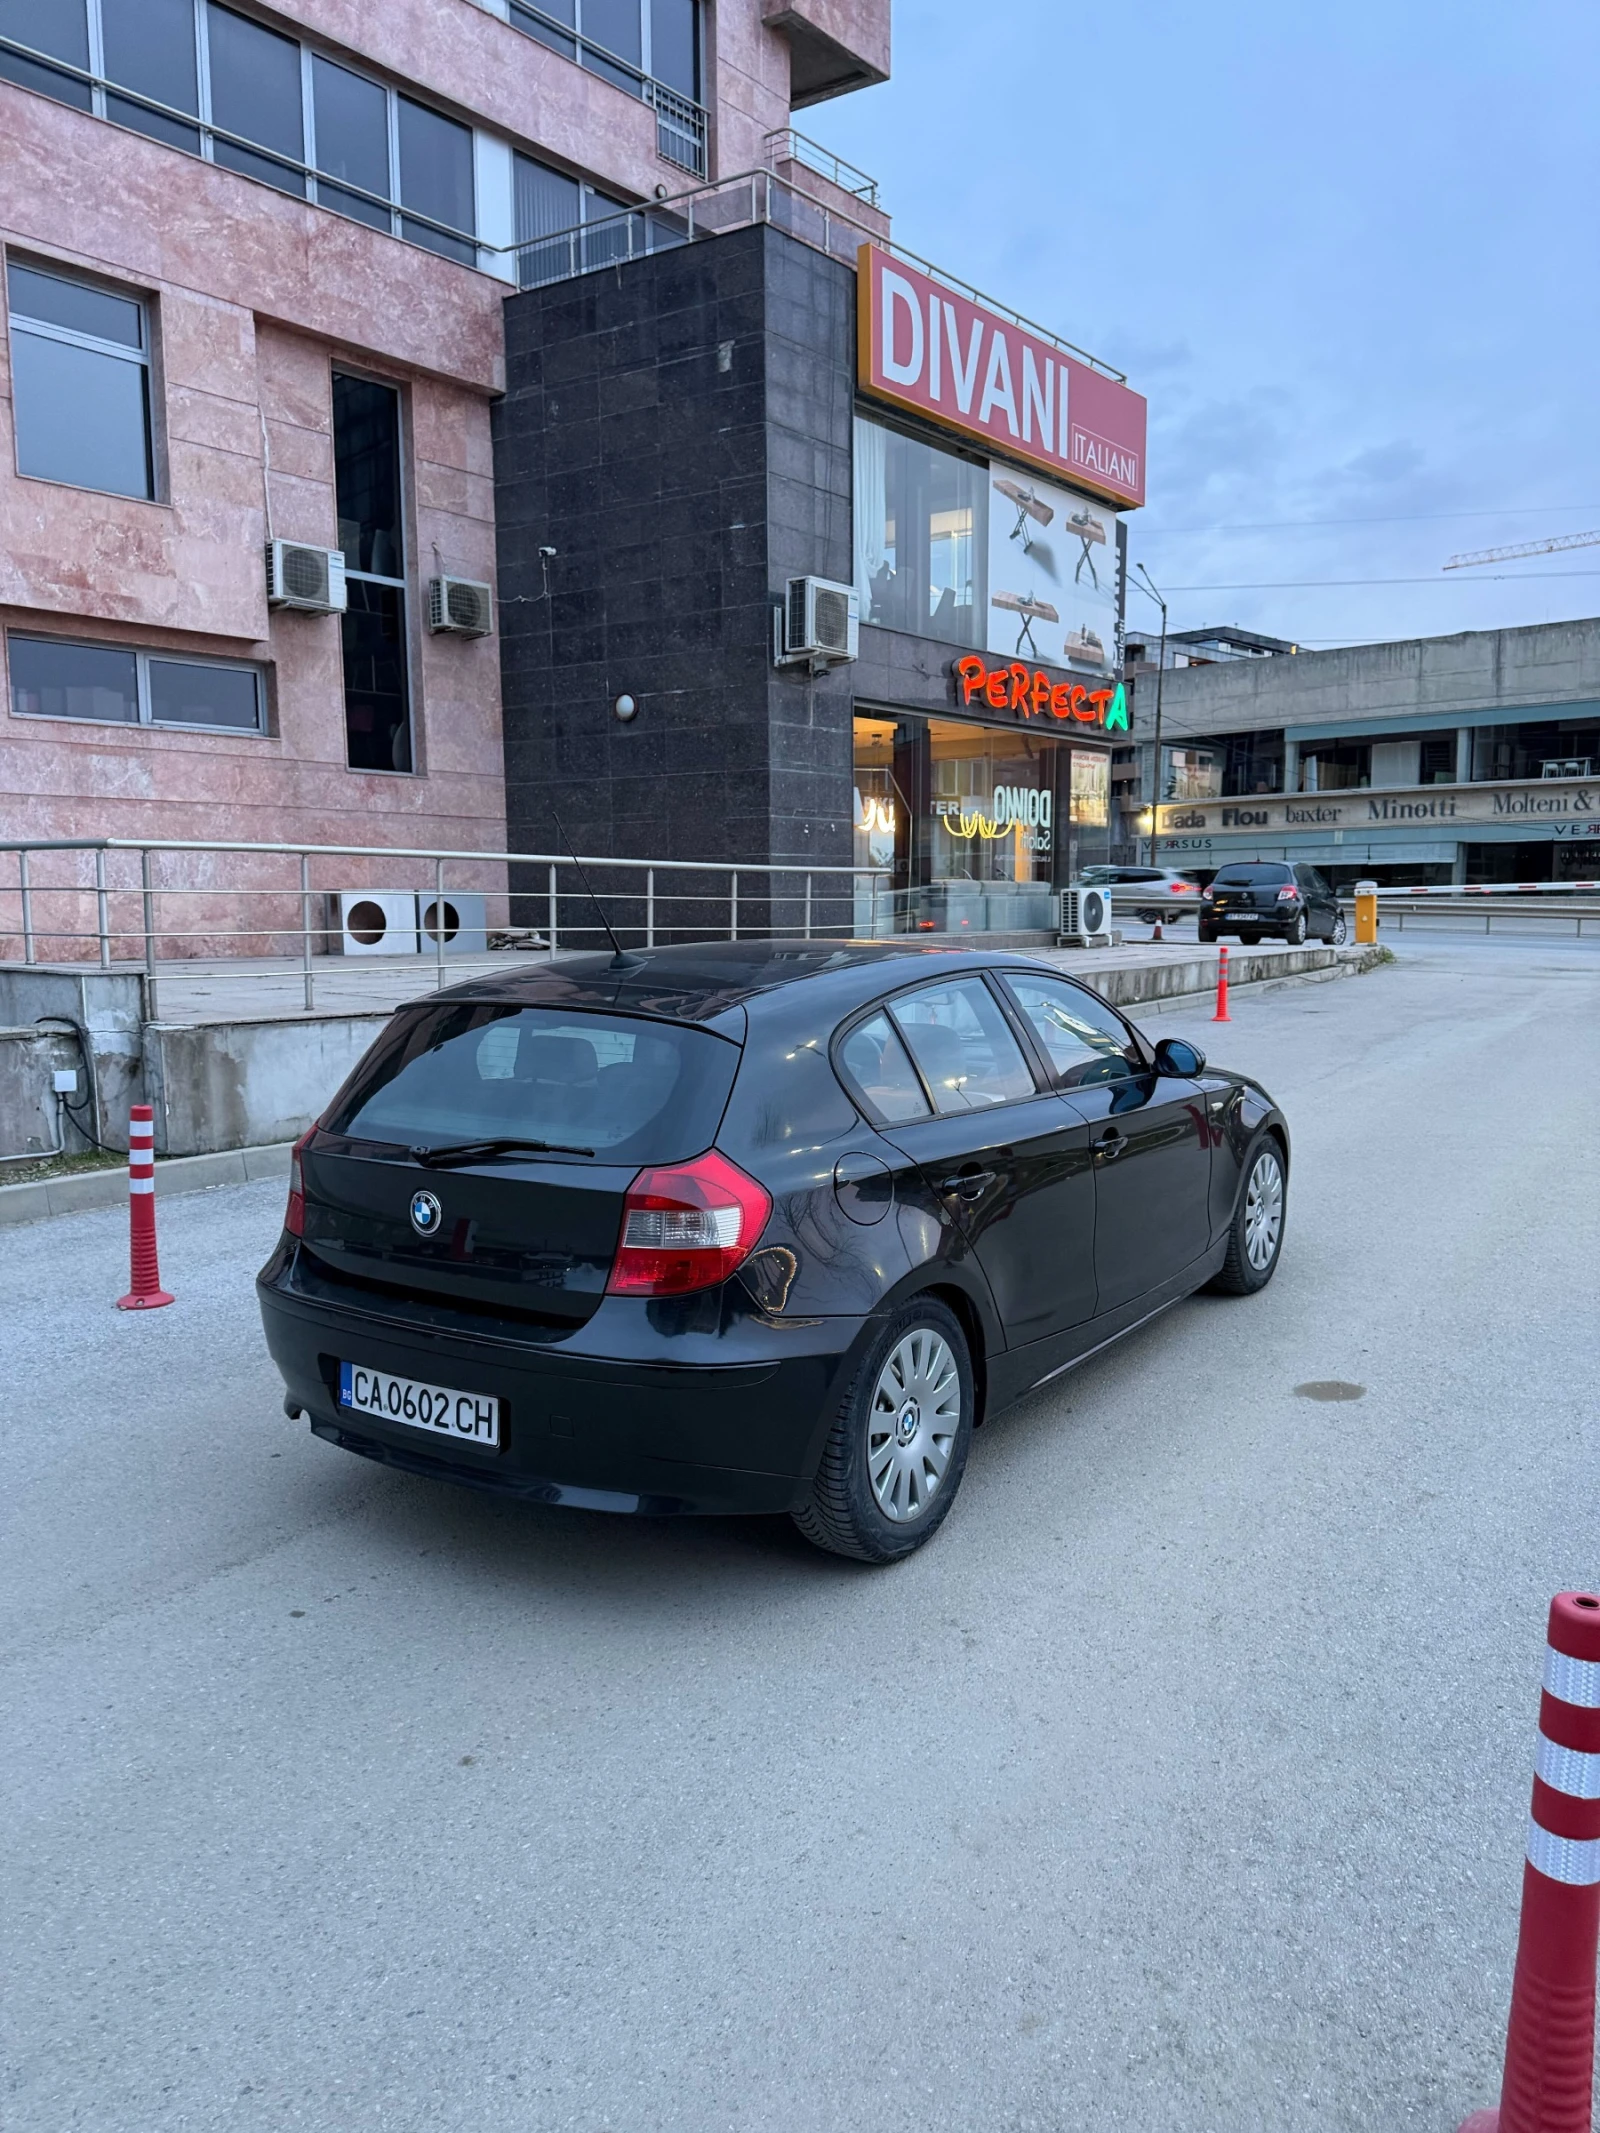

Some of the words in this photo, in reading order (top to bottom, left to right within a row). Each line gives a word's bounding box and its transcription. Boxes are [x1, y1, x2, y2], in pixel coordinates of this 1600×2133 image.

[881, 266, 1069, 460] DIVANI
[1073, 432, 1137, 487] ITALIANI
[958, 654, 1129, 731] PERFECTA
[1222, 808, 1268, 827] Flou
[1285, 804, 1342, 823] baxter
[1368, 796, 1457, 820] Minotti
[1492, 791, 1568, 815] Molteni
[1574, 789, 1594, 811] &
[342, 1388, 352, 1401] BG
[355, 1371, 493, 1439] CA0602CH
